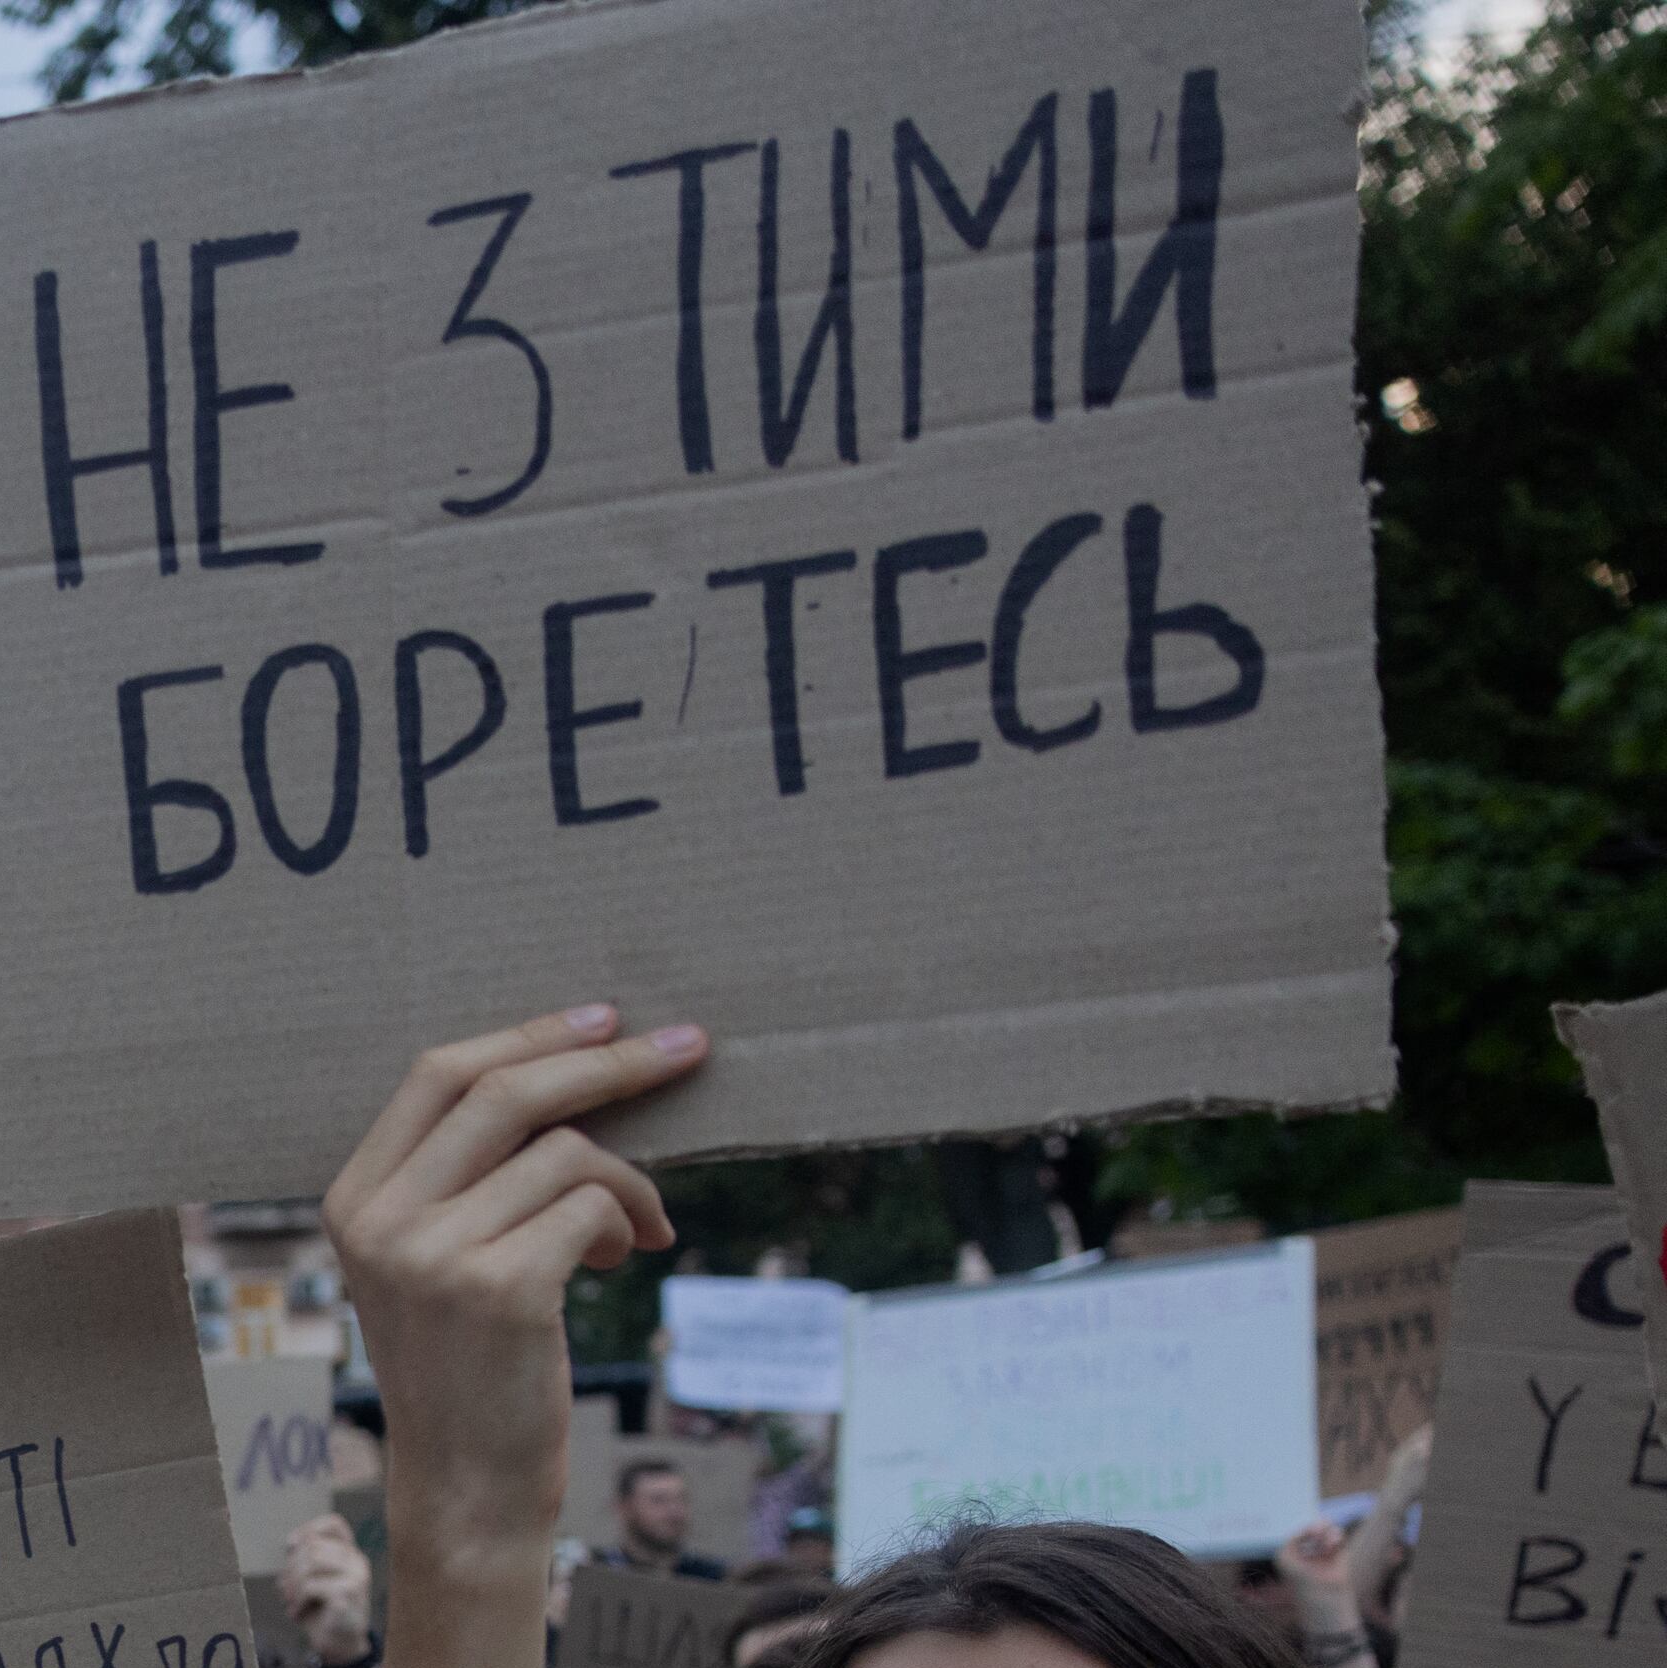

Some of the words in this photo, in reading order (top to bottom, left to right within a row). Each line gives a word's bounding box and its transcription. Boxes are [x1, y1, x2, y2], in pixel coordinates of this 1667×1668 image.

[35, 230, 325, 589] НЕ
[426, 193, 554, 517] З
[608, 68, 1224, 476] ТИМИ
[117, 504, 1264, 895] БОРЕТЕСЬ
